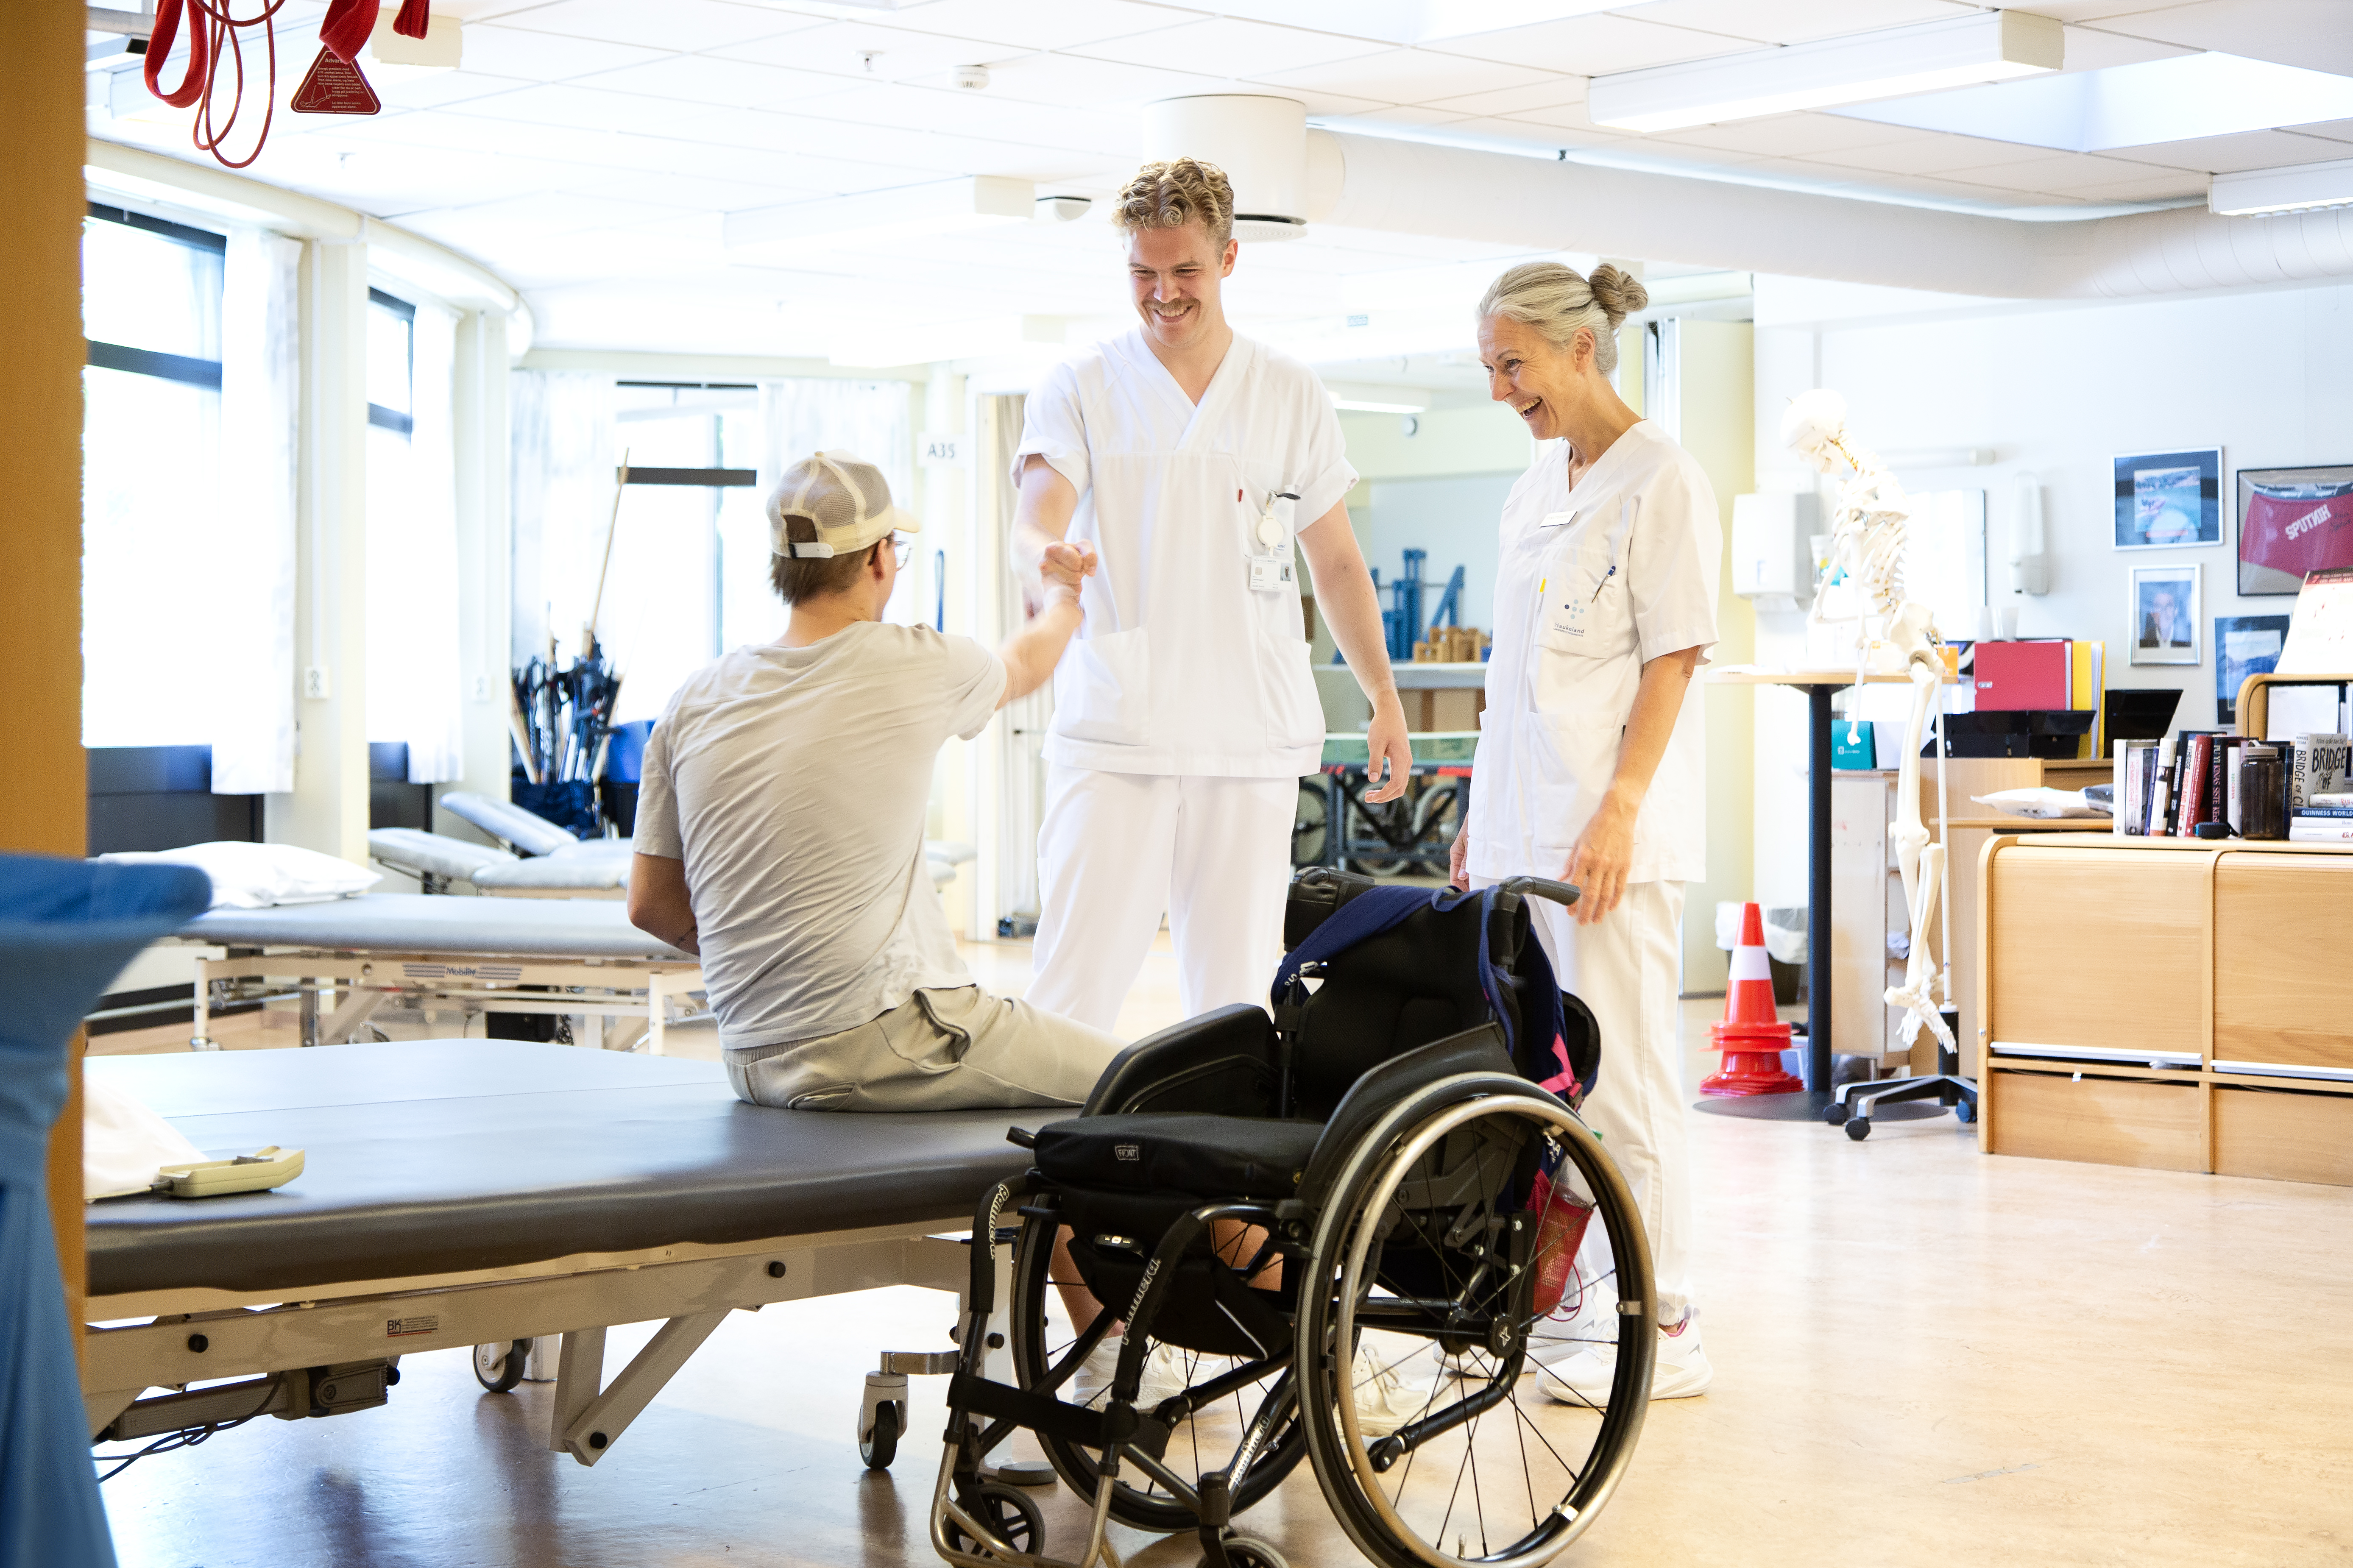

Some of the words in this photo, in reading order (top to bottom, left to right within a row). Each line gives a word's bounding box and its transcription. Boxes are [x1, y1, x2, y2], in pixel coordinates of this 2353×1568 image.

[927, 443, 955, 459] A35
[1555, 622, 1585, 633] Haukeland
[2312, 746, 2346, 773] BRIDGE
[2294, 750, 2306, 783] BRIDGE
[2180, 771, 2190, 803] RUSSLAND
[2295, 785, 2301, 794] OF
[446, 967, 476, 977] Mobility
[1118, 1149, 1136, 1157] FRONT
